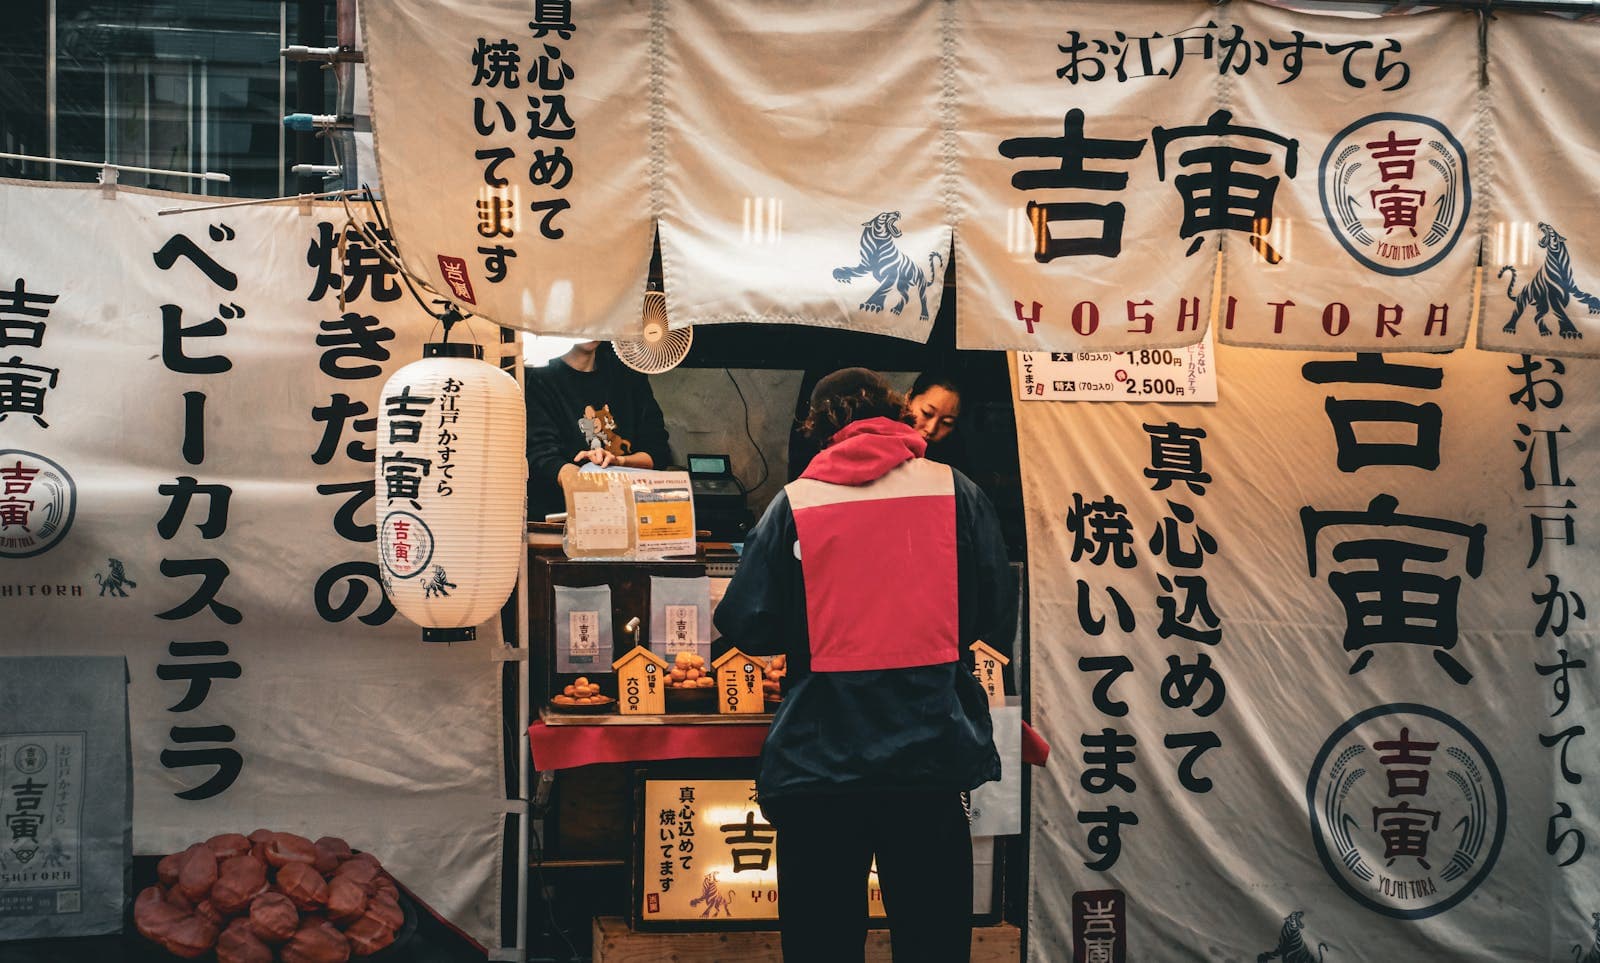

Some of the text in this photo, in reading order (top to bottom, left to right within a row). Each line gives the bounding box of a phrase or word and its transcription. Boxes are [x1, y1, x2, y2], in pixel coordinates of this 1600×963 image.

[1056, 20, 1411, 92] お江戸かすてら
[471, 38, 520, 283] 焼いてます
[998, 108, 1299, 264] 吉寅
[1366, 131, 1426, 238] 吉寅
[0, 278, 60, 429] 吉寅
[1013, 296, 1449, 339] YOSHITORA
[1023, 351, 1035, 395] いてます
[1127, 350, 1182, 367] 1,800円
[307, 221, 403, 626] 焼きたての
[436, 377, 464, 497] お江戸かすてら
[1126, 379, 1185, 396] 2,500円
[0, 461, 41, 533] 吉寅
[381, 386, 436, 511] 吉寅
[152, 223, 246, 801] ベビーカステラ
[393, 520, 412, 563] 吉寅
[1142, 422, 1226, 794] 真心込めて
[1507, 354, 1587, 868] お江戸かすてら
[1066, 493, 1139, 872] 焼いてます
[6, 777, 49, 844] 吉寅
[659, 809, 676, 892] 焼いてます
[678, 786, 696, 870] 真心込めて
[1372, 727, 1441, 870] 吉寅
